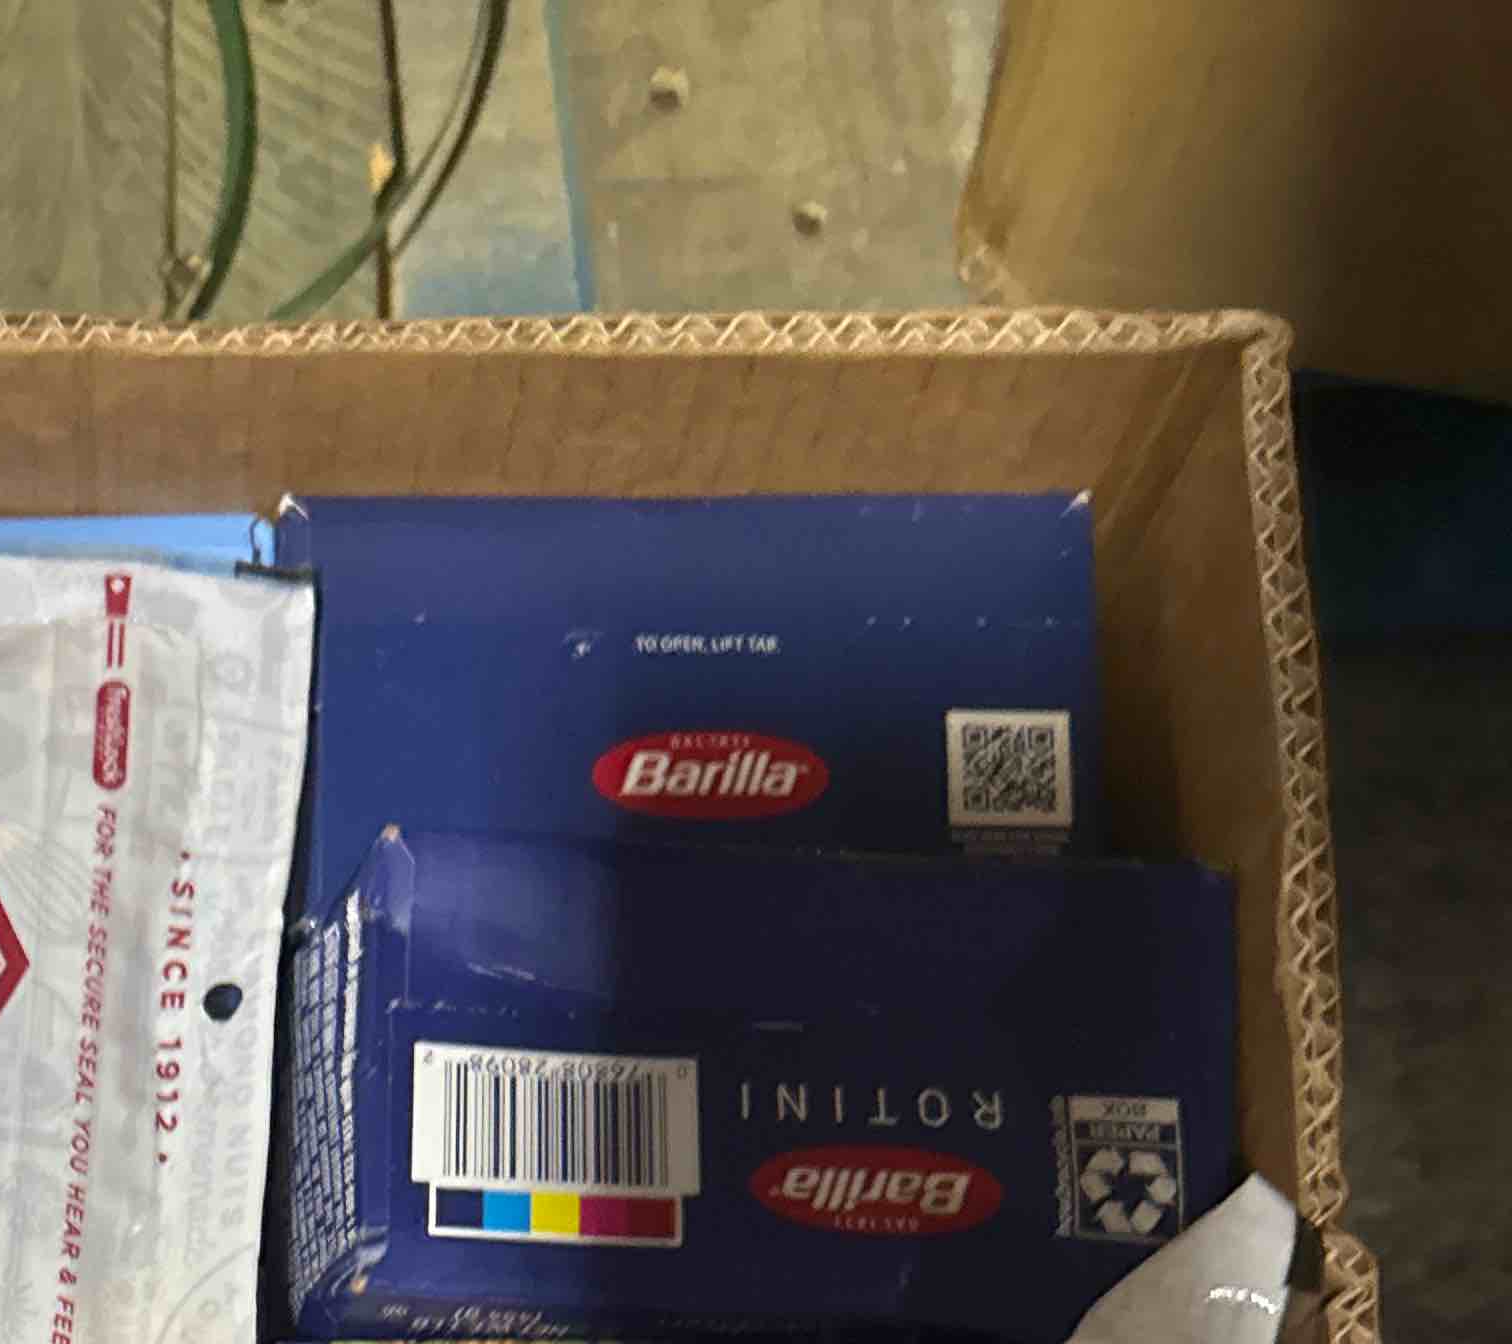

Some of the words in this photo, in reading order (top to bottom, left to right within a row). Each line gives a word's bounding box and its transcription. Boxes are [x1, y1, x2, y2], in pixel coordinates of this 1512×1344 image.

[619, 750, 800, 798] Barilla
[95, 807, 118, 857] FOR
[91, 866, 112, 917] THE
[159, 880, 195, 1010] SINCE
[84, 925, 109, 1030] SECURE
[76, 1037, 102, 1109] SEAL
[152, 1037, 184, 1133] 1912
[741, 1083, 1003, 1130] ROTINI
[70, 1119, 94, 1177] YOU
[784, 1167, 971, 1211] Barilla
[61, 1185, 87, 1261] HEAR
